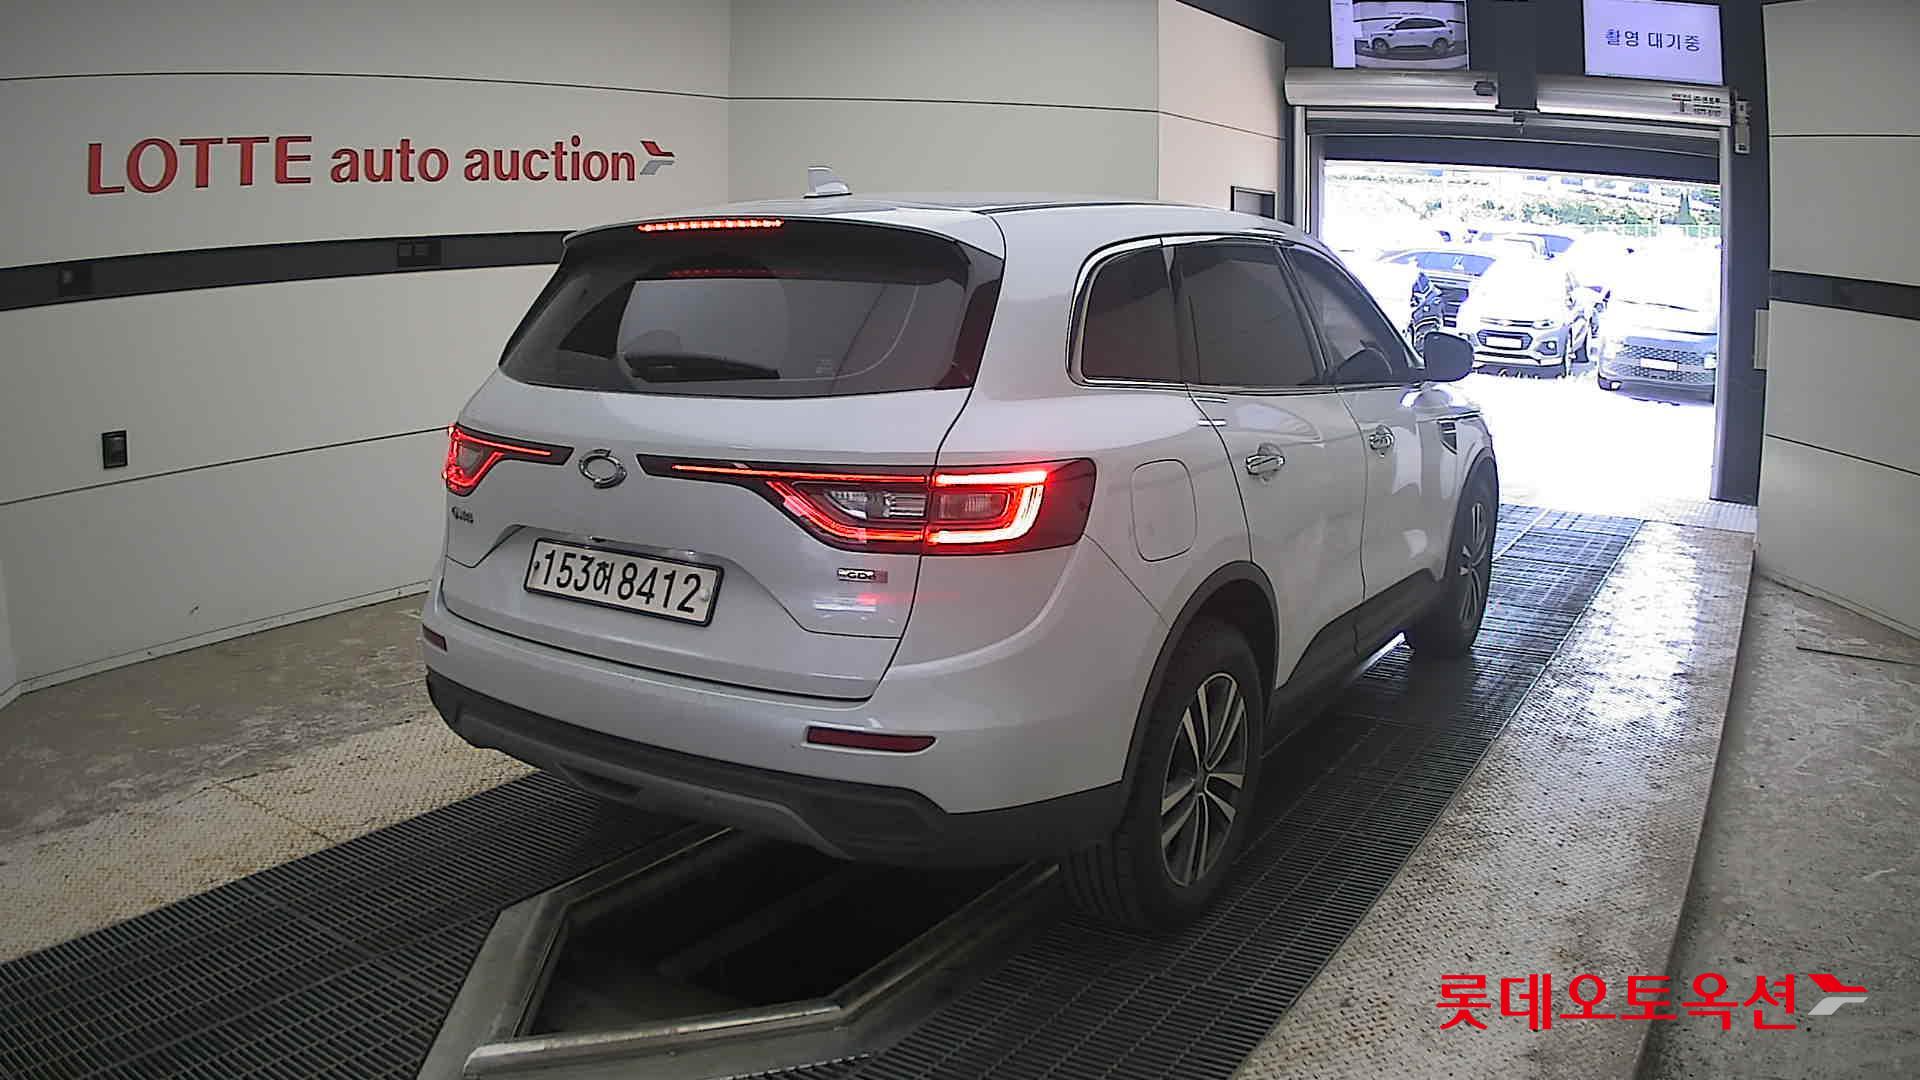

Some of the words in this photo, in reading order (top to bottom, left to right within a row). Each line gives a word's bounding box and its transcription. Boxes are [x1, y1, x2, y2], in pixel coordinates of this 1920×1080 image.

[1647, 32, 1700, 52] 대기중
[87, 135, 312, 195] LOTTE
[330, 138, 449, 182] auto
[464, 135, 636, 182] auction
